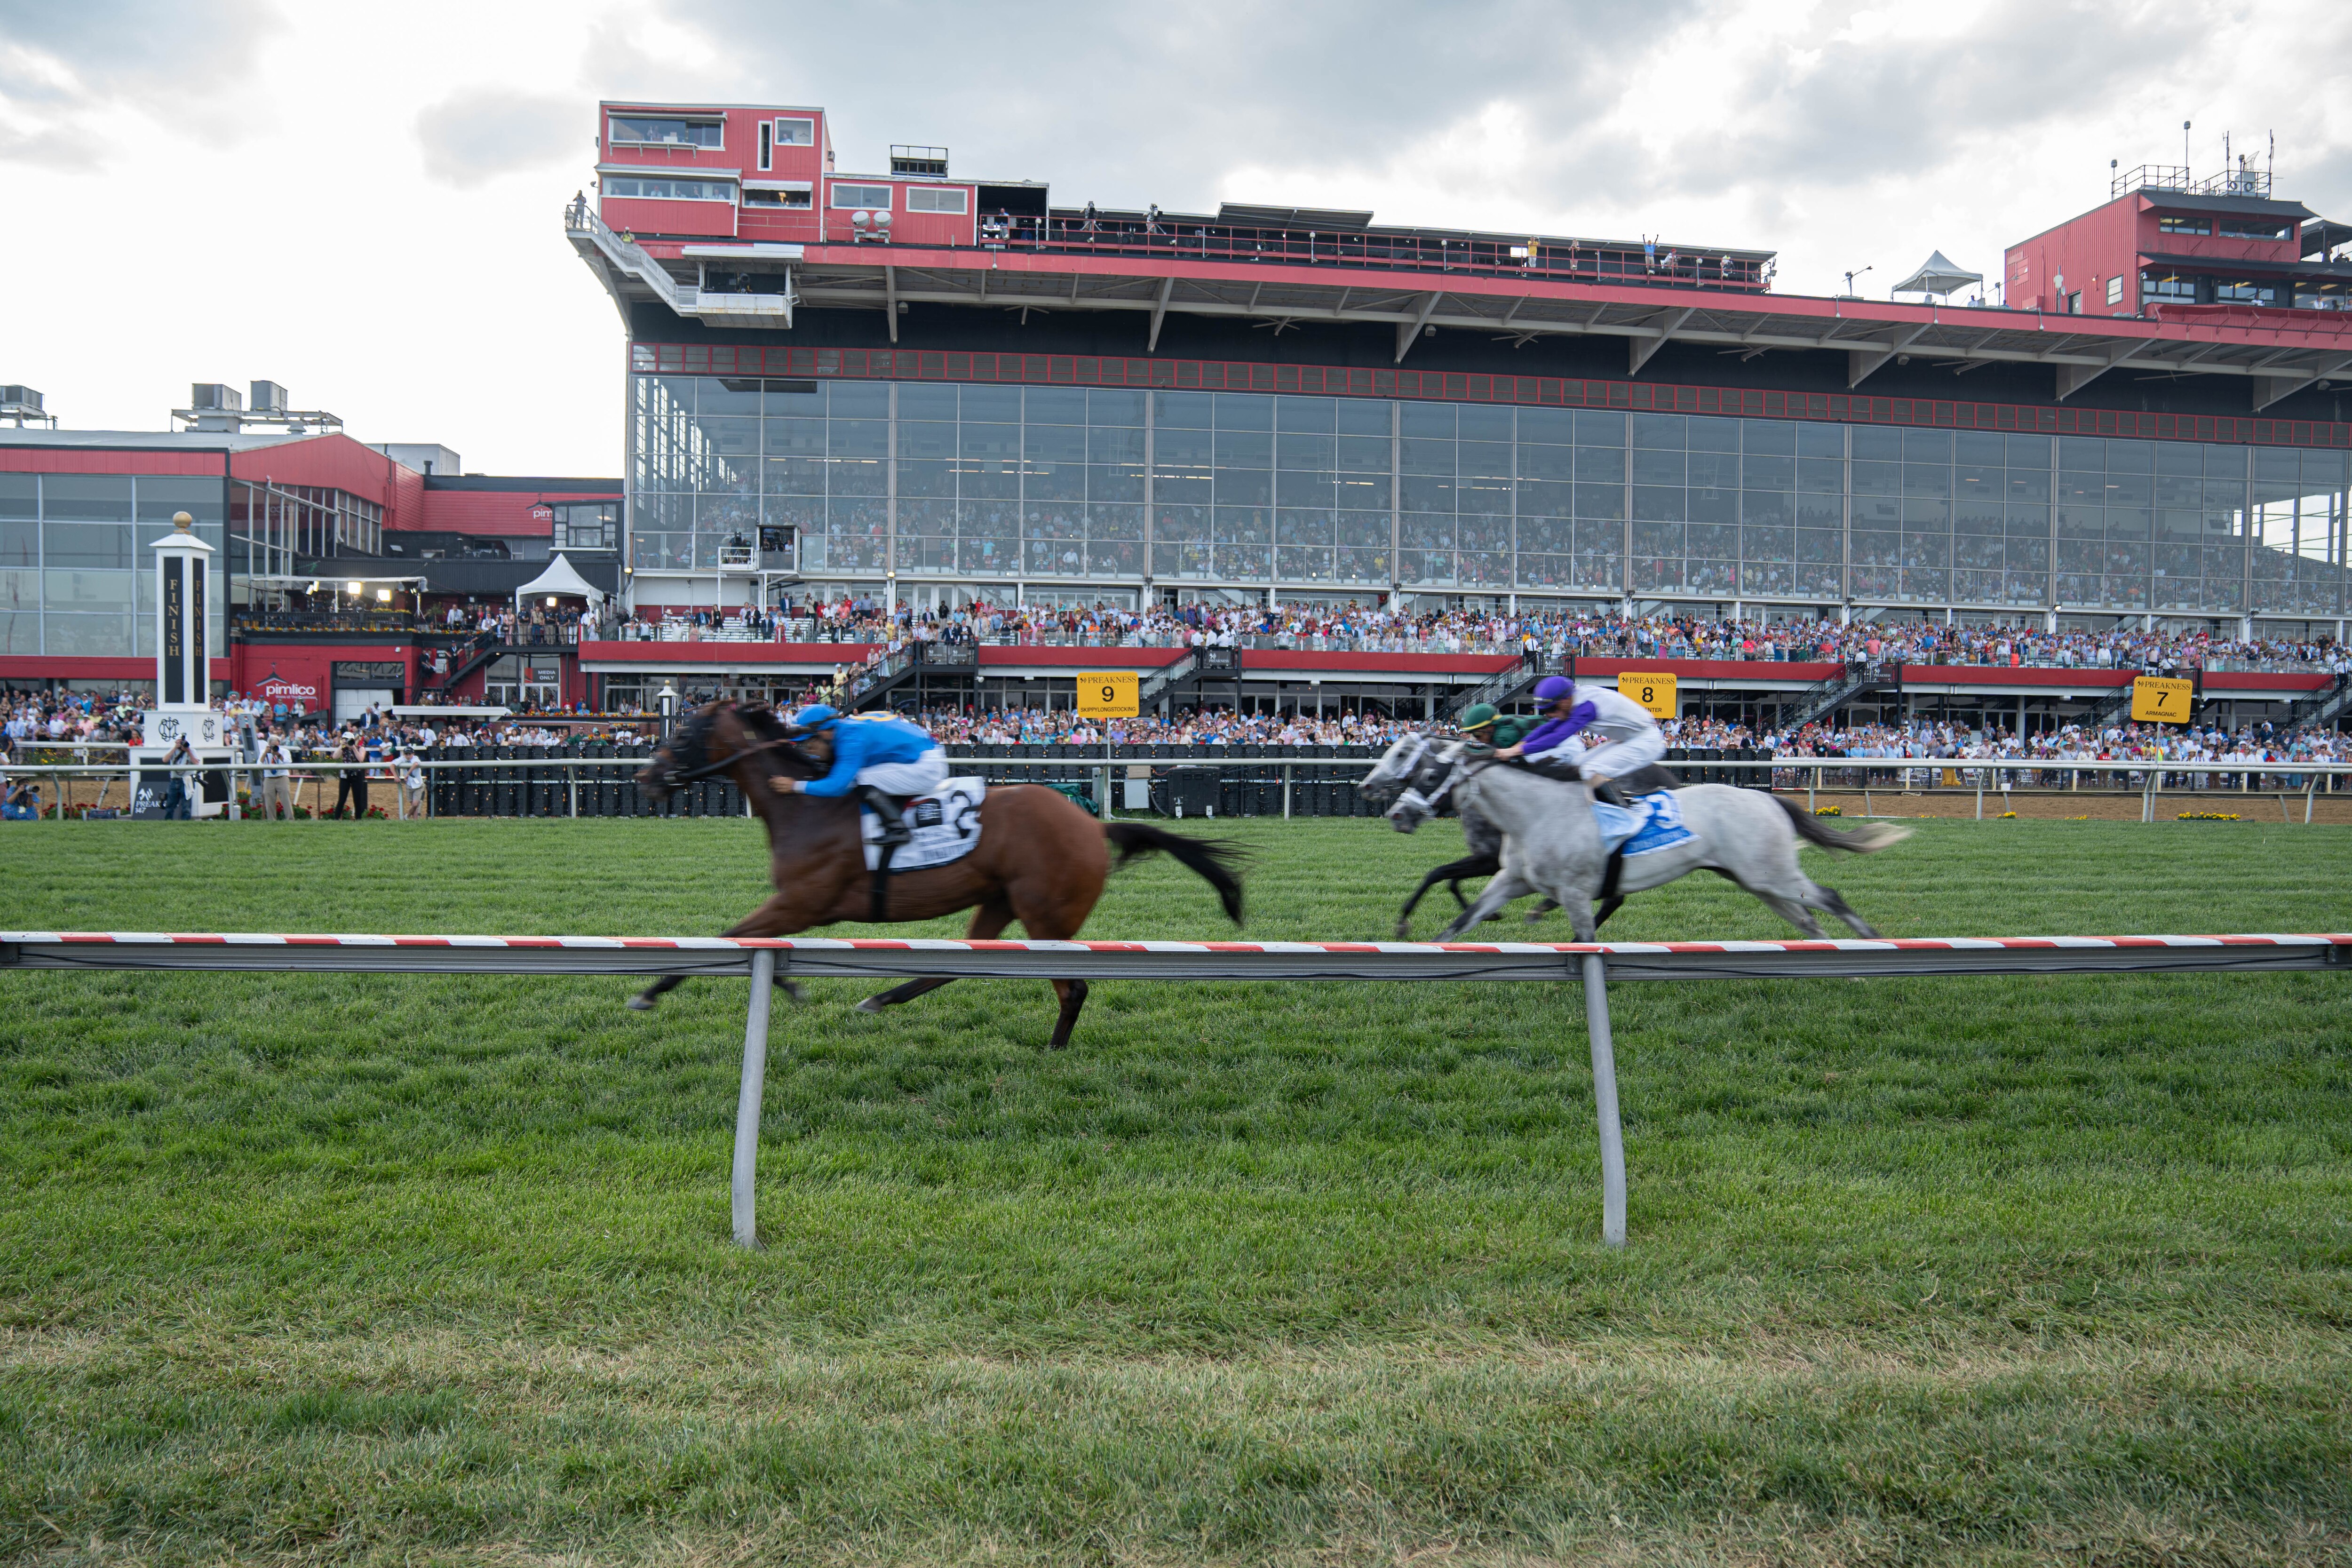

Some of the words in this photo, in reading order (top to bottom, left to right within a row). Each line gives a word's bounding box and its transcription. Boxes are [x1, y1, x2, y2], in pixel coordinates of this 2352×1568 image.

[533, 508, 552, 519] pim
[167, 579, 180, 656] FINISH
[266, 684, 316, 697] pimlico
[2145, 681, 2191, 691] PREAKNESS
[1101, 686, 1114, 702] 9
[1642, 687, 1653, 703] 8
[2157, 692, 2169, 707] 7
